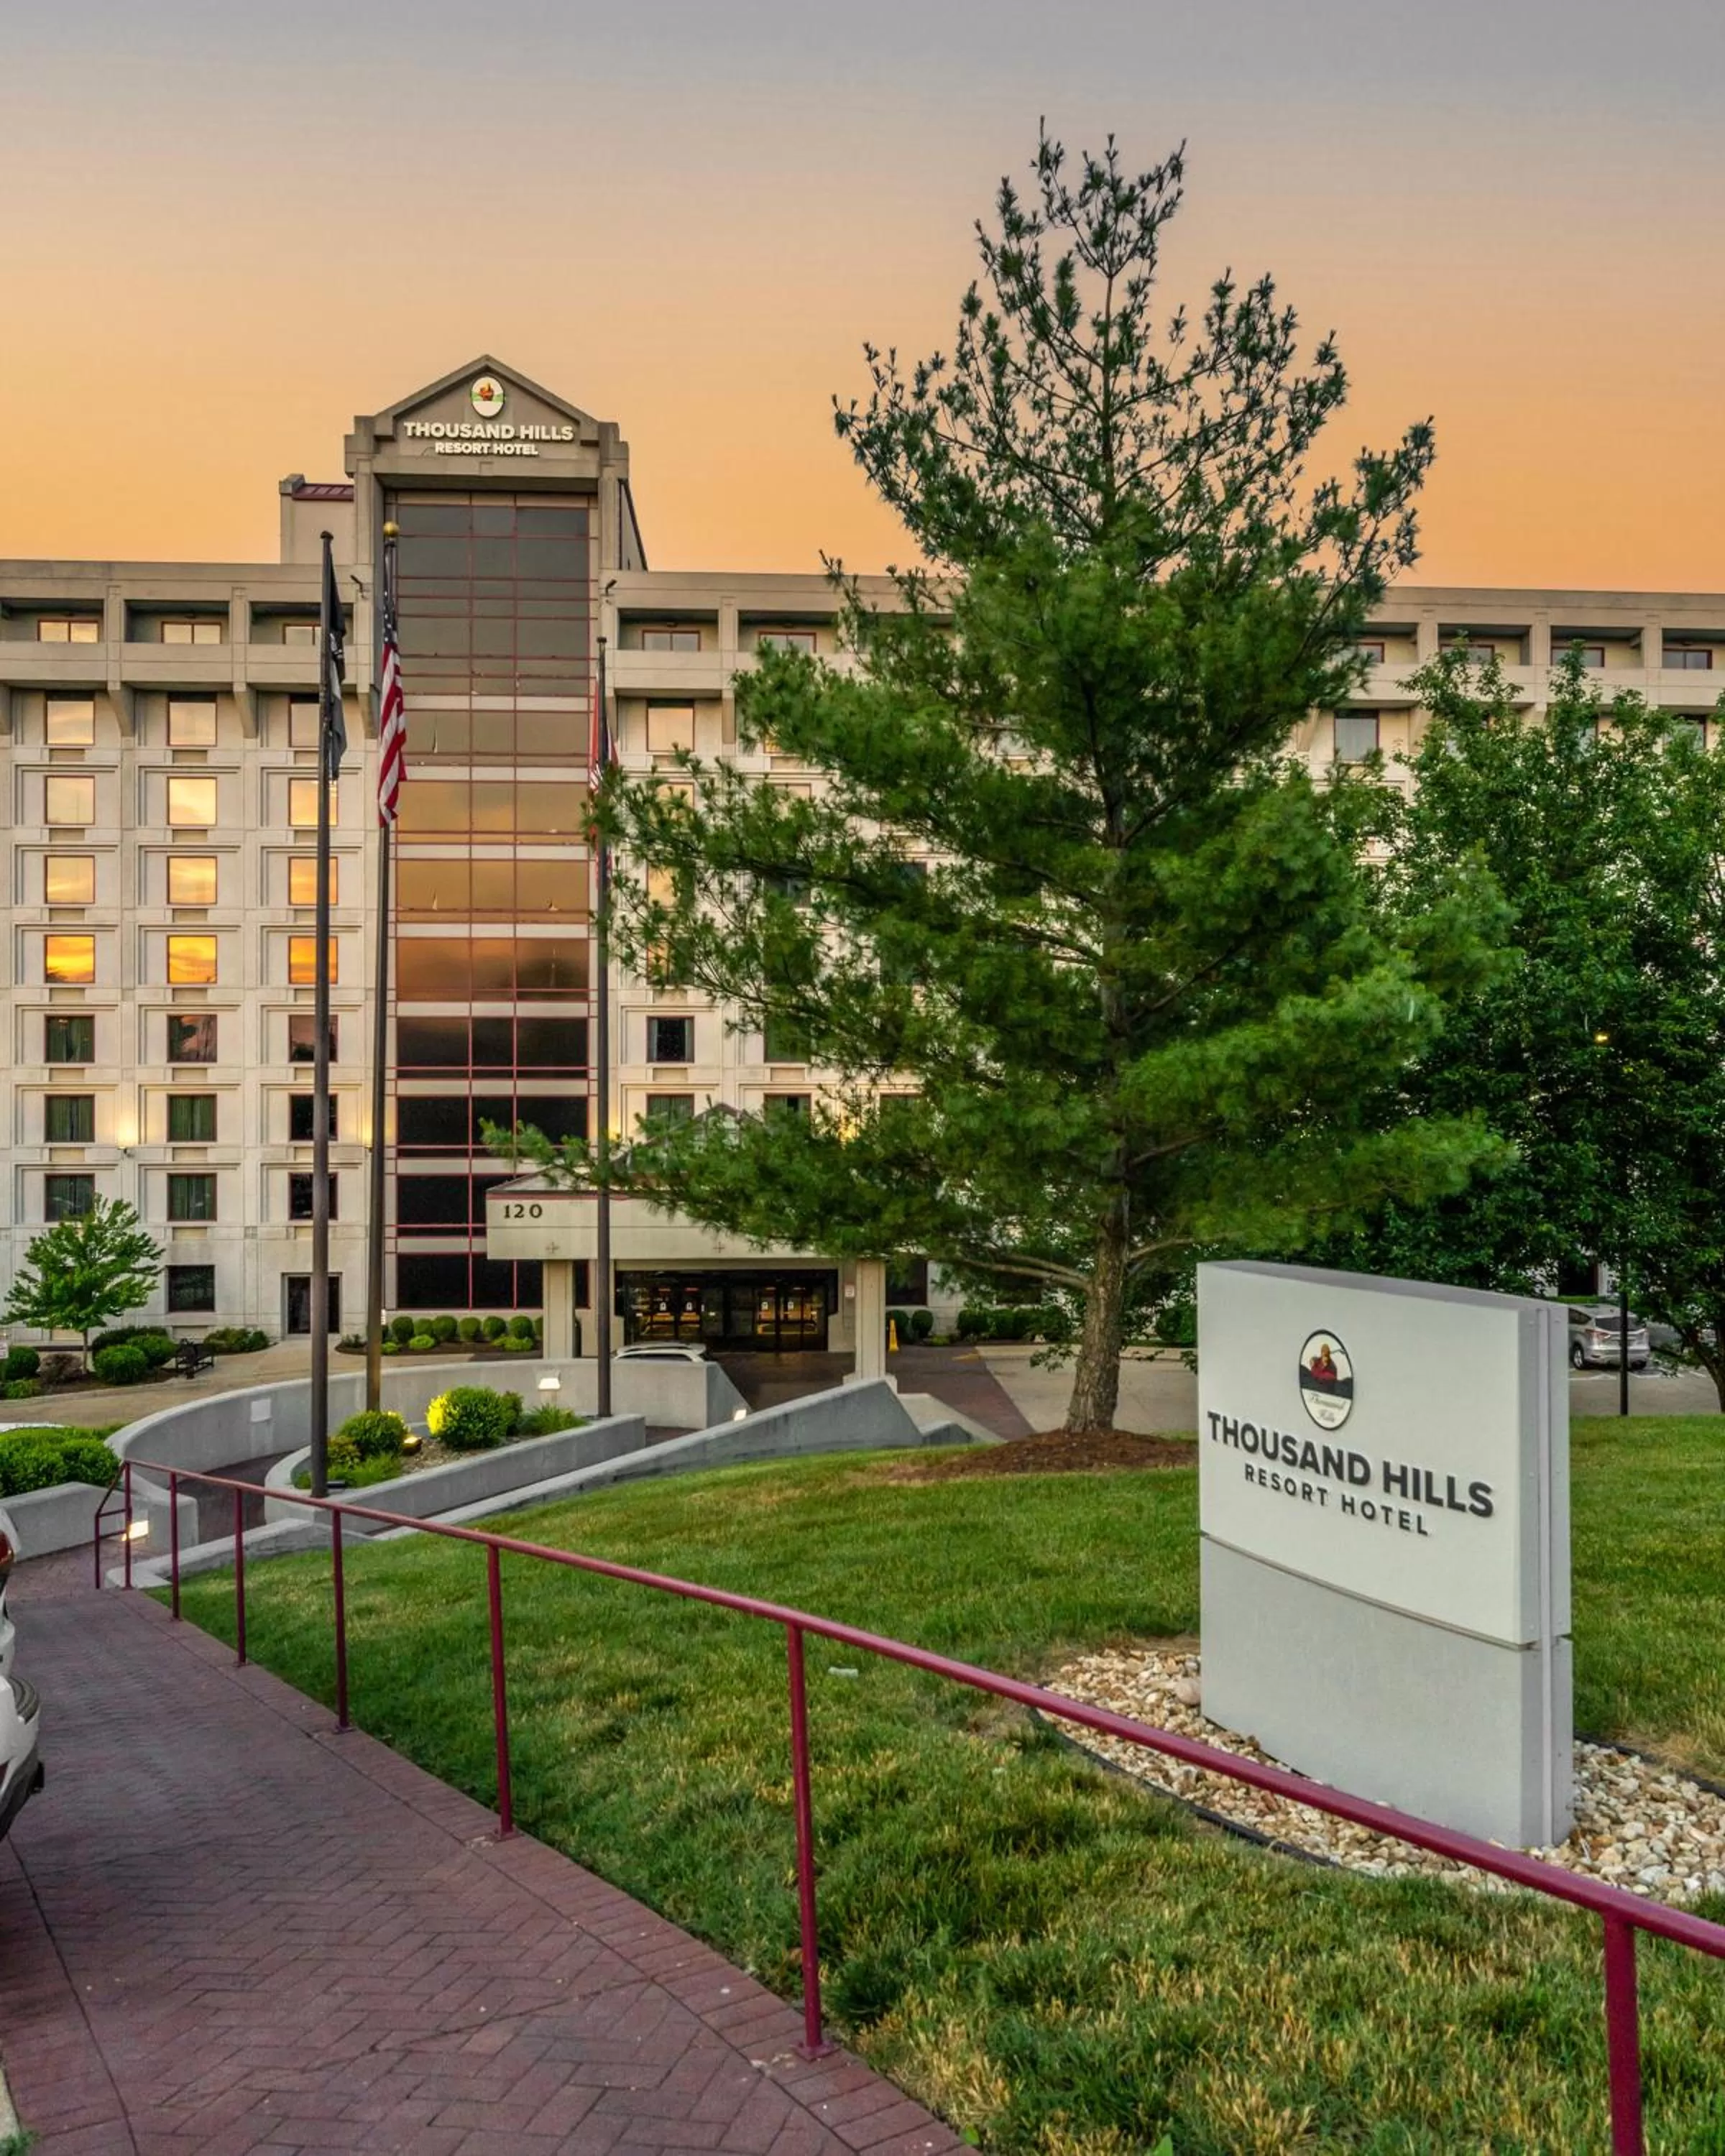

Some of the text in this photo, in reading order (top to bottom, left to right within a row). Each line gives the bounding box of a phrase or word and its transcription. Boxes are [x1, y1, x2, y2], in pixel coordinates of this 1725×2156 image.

[403, 422, 574, 441] THOUSAND HILLS
[434, 442, 538, 456] RESORT HOTEL
[505, 1204, 543, 1219] 120
[1208, 1411, 1494, 1518] THOUSAND HILLS
[1244, 1464, 1428, 1536] RESORT HOTEL
